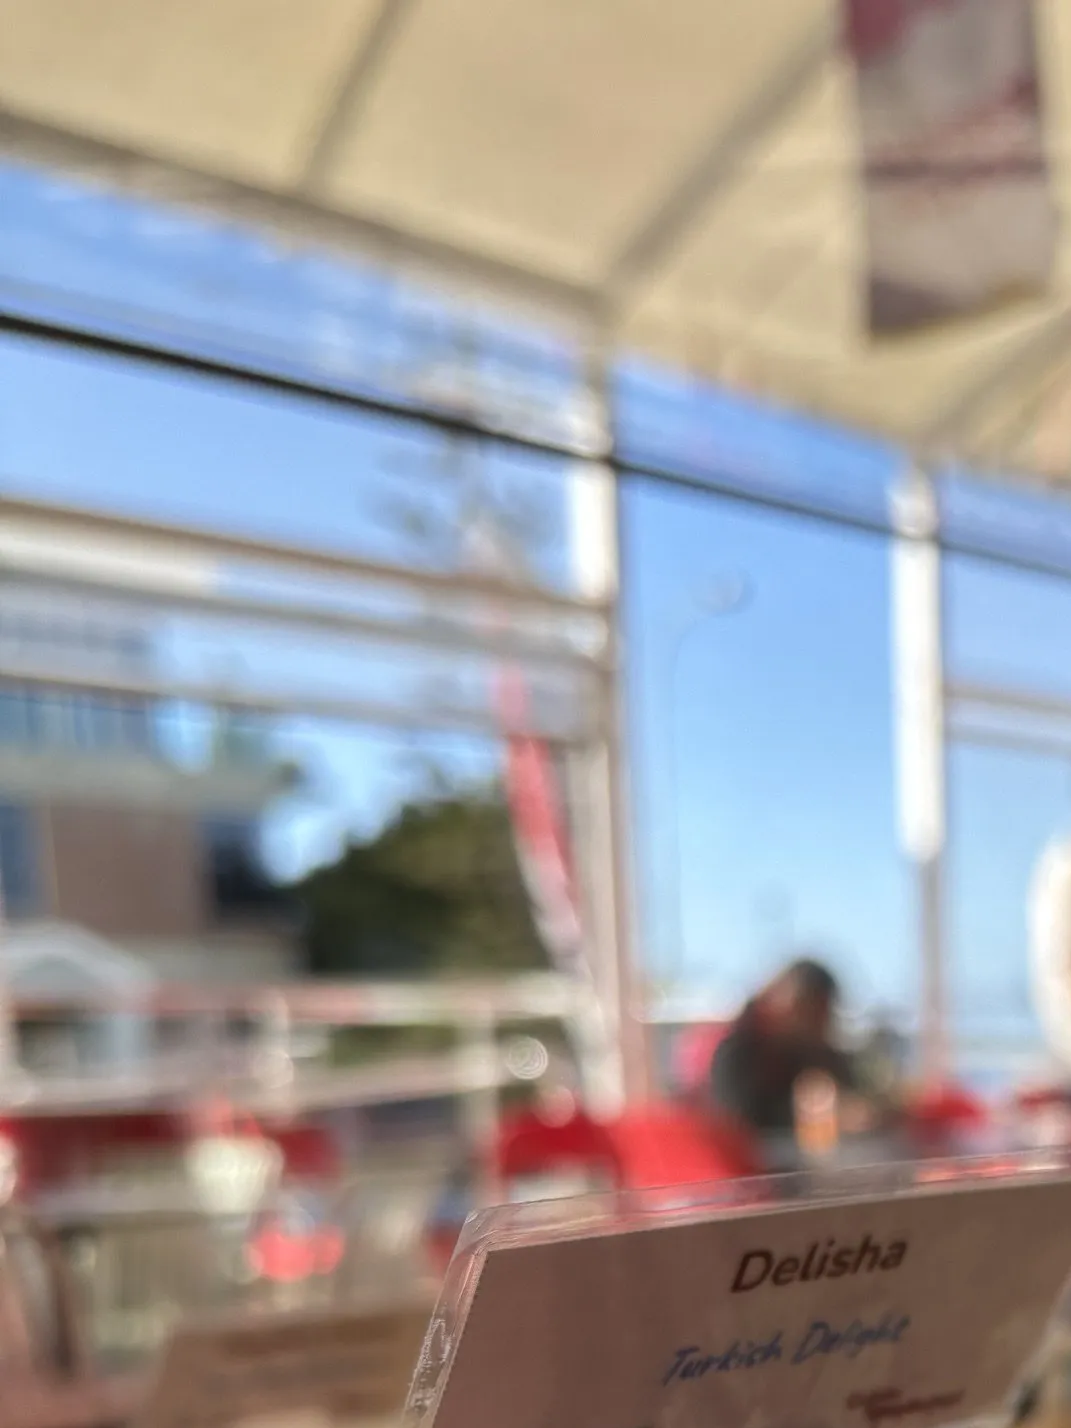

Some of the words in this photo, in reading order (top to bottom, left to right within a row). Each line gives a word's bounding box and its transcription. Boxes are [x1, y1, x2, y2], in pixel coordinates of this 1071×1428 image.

[731, 1234, 908, 1293] Delisha
[663, 1330, 783, 1387] Turkish
[791, 1313, 911, 1365] Delight
